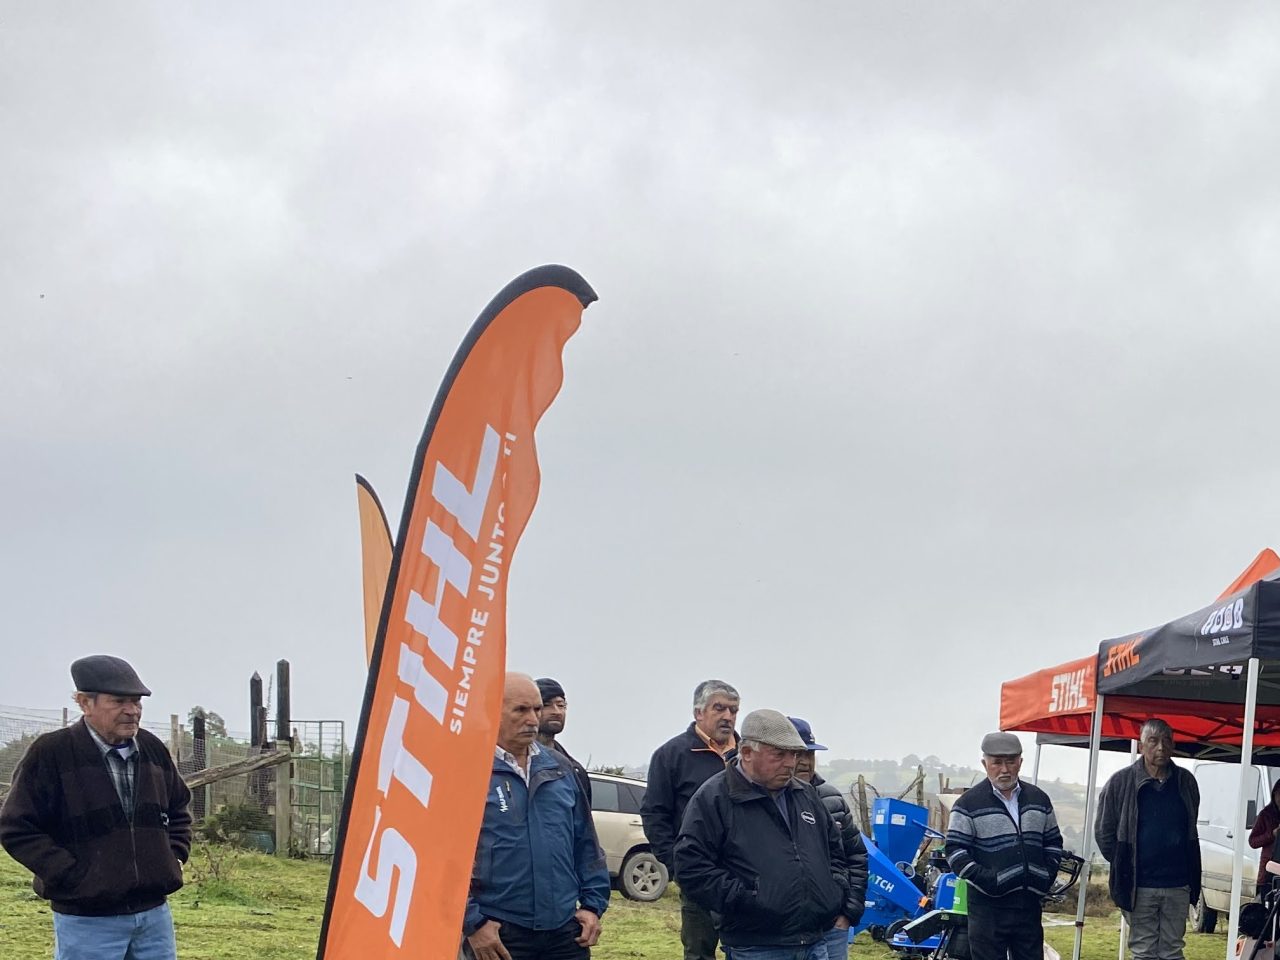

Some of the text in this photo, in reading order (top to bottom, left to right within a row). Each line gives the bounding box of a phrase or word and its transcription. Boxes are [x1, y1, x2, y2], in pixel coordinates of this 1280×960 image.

[353, 423, 501, 947] STIHL
[450, 608, 490, 736] SIEMPRE
[1049, 667, 1088, 713] STIHL
[1103, 636, 1143, 677] STIHL
